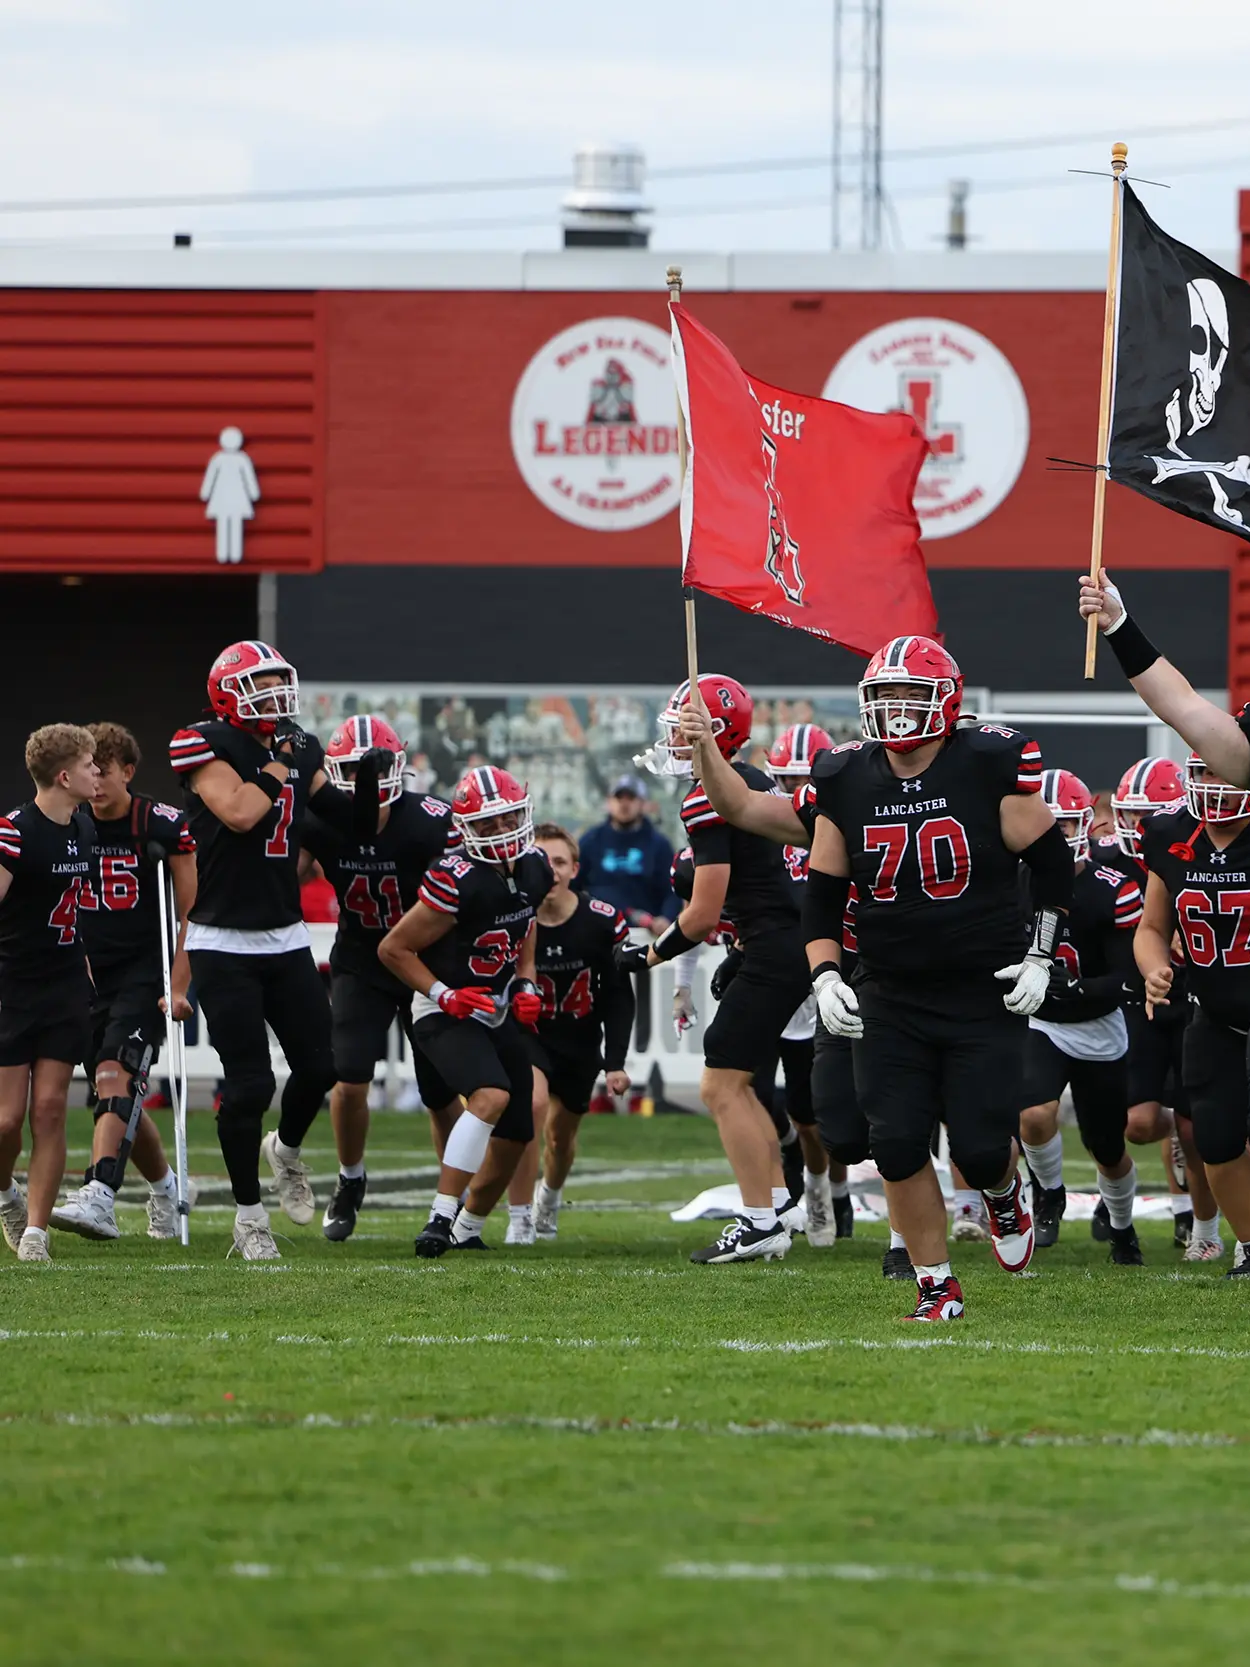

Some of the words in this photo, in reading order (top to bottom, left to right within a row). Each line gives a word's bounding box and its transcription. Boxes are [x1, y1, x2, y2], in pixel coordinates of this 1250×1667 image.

[534, 419, 678, 457] LEGEND
[715, 687, 735, 709] 2
[874, 797, 947, 817] LANCASTER
[264, 784, 294, 857] 7
[51, 861, 90, 873] LANCASTER
[339, 859, 397, 871] LANCASTER
[863, 816, 972, 901] 70
[1185, 871, 1247, 883] LANCASTER
[343, 874, 404, 930] 41
[494, 905, 534, 925] LANCASTER
[536, 959, 585, 972] ANCASTER
